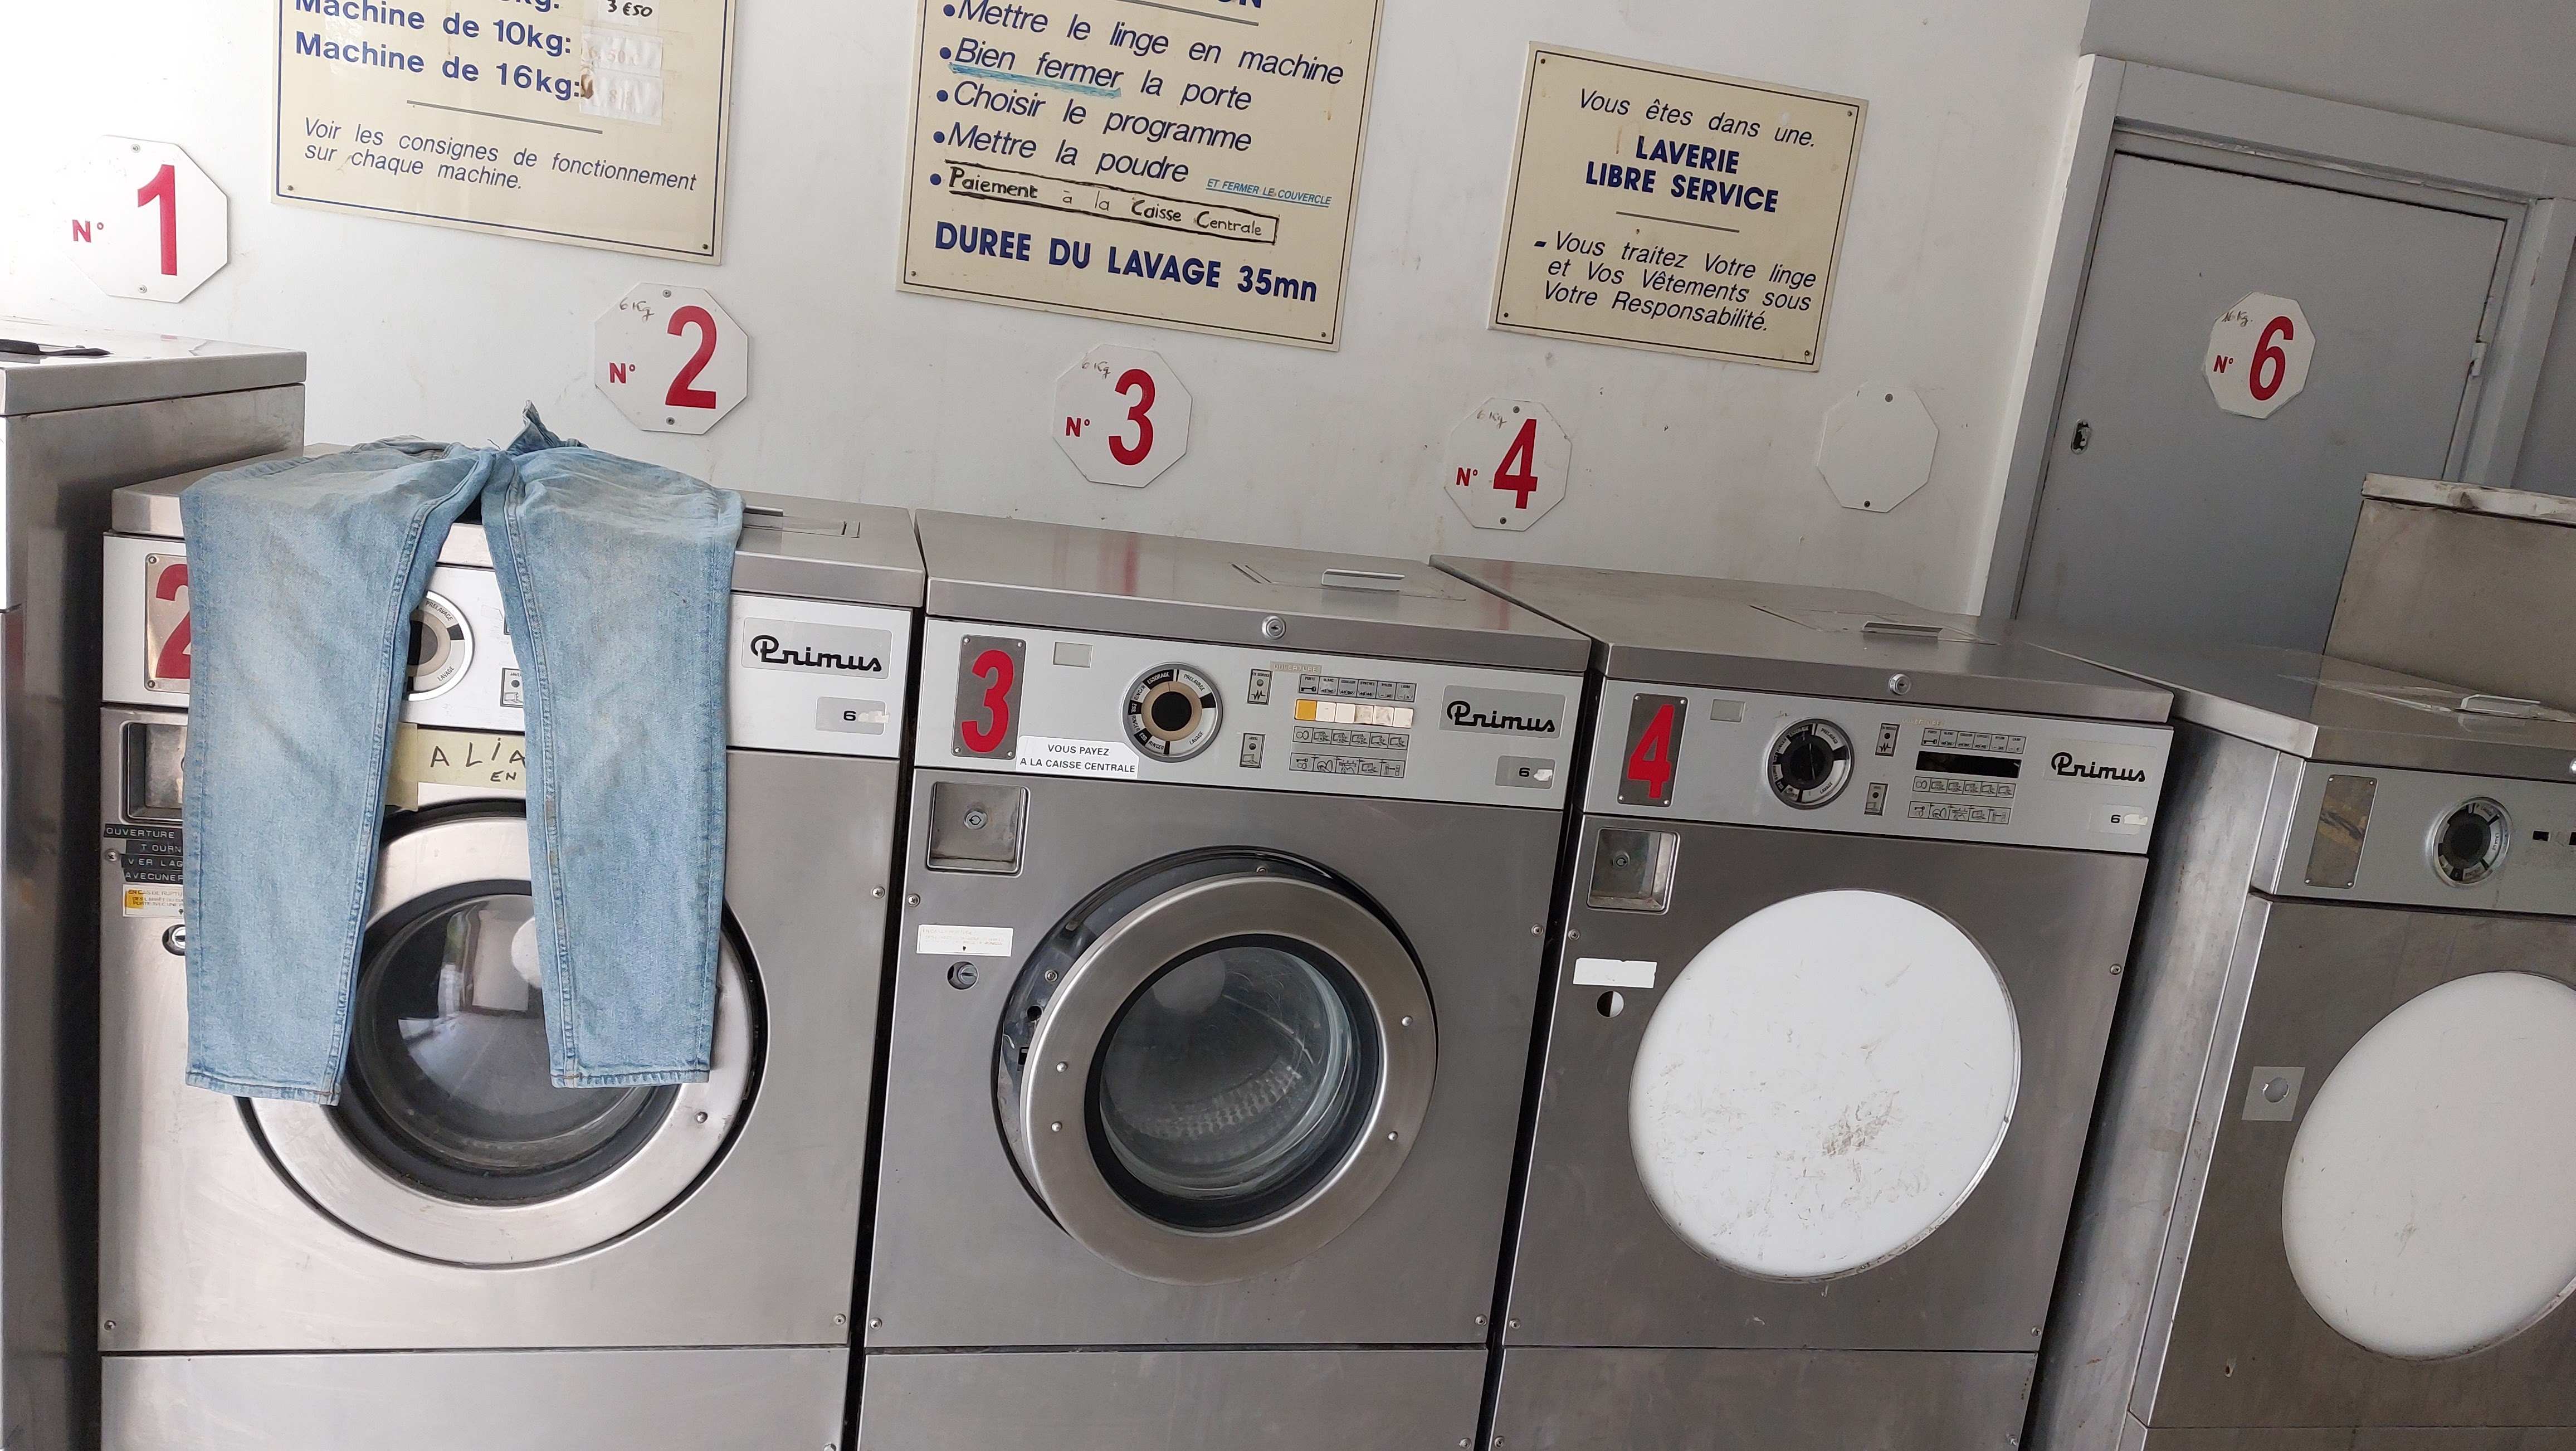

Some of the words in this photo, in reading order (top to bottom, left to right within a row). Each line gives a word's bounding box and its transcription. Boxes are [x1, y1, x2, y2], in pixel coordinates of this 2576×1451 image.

[442, 12, 480, 39] de
[492, 18, 571, 57] 10kg:
[957, 0, 1048, 33] Mettre
[1066, 13, 1091, 41] le
[1109, 21, 1169, 56] linge
[1188, 41, 1222, 64] en
[1237, 53, 1344, 84] machine
[296, 30, 425, 73] Machine
[441, 55, 479, 84] de
[495, 62, 579, 101] 16kg:
[954, 37, 1016, 71] Bien
[1035, 51, 1125, 89] fermer
[1140, 69, 1163, 96] la
[1179, 83, 1252, 110] porte
[954, 80, 1046, 117] Choisir
[1062, 98, 1087, 124] le
[1102, 111, 1252, 153] programme
[1580, 87, 1630, 115] Vous
[1645, 98, 1693, 126] êtes
[1708, 111, 1760, 138] dans
[1774, 126, 1815, 148] une.
[304, 144, 338, 162] sur
[350, 148, 424, 176] chaque
[436, 163, 522, 190] machine.
[305, 116, 341, 140] Voir
[355, 123, 384, 147] les
[398, 134, 499, 162] consignes
[513, 147, 536, 168] de
[552, 152, 697, 192] fonctionnement
[947, 121, 1037, 158] Mettre
[1055, 139, 1079, 166] la
[1095, 153, 1189, 183] poudre
[1635, 135, 1740, 174] LAVERIE
[949, 166, 1038, 199] Paiement
[1094, 190, 1110, 211] la
[1131, 199, 1182, 222] Caisse
[1196, 211, 1262, 236] Centrale
[1207, 178, 1221, 189] ET
[1222, 181, 1260, 194] FERMER
[1262, 187, 1276, 197] LE
[1277, 189, 1333, 206] COUVERCLE
[1585, 160, 1656, 193] LIBRE
[1671, 174, 1779, 213] SERVICE
[934, 220, 1032, 261] DUREE
[1048, 237, 1091, 269] DU
[1108, 246, 1221, 288] LAVAGE
[1237, 265, 1317, 302] 35mn
[1547, 257, 1572, 277] et
[1587, 260, 1624, 285] Vos
[1641, 268, 1750, 304] Vêtements
[1762, 290, 1812, 311] sous
[1555, 230, 1606, 257] Vous
[1621, 241, 1690, 269] traitez
[1703, 252, 1757, 279] Votre
[1768, 261, 1817, 290] linge
[1544, 280, 1598, 306] Votre
[1611, 290, 1768, 332] Responsabilité.
[665, 305, 717, 410] 2
[2249, 315, 2294, 401] 6
[1108, 368, 1155, 466] 3
[1492, 418, 1538, 509] 4
[425, 600, 453, 622] PRELAVAGE
[437, 665, 455, 681] LAVAGE
[750, 634, 882, 672] Primus
[960, 649, 1014, 753] 3
[1183, 673, 1206, 692] PRELAVAGE
[1446, 700, 1557, 733] Primus
[1019, 757, 1027, 766] A
[1030, 758, 1042, 767] LA
[1045, 759, 1081, 769] CAISSE
[1084, 762, 1136, 773] CENTRALE
[1047, 744, 1076, 754] VOUS
[1079, 746, 1110, 756] PAYEZ
[1627, 704, 1675, 798] 4
[2051, 751, 2146, 782] Primus
[106, 827, 175, 839] OUVERTURE
